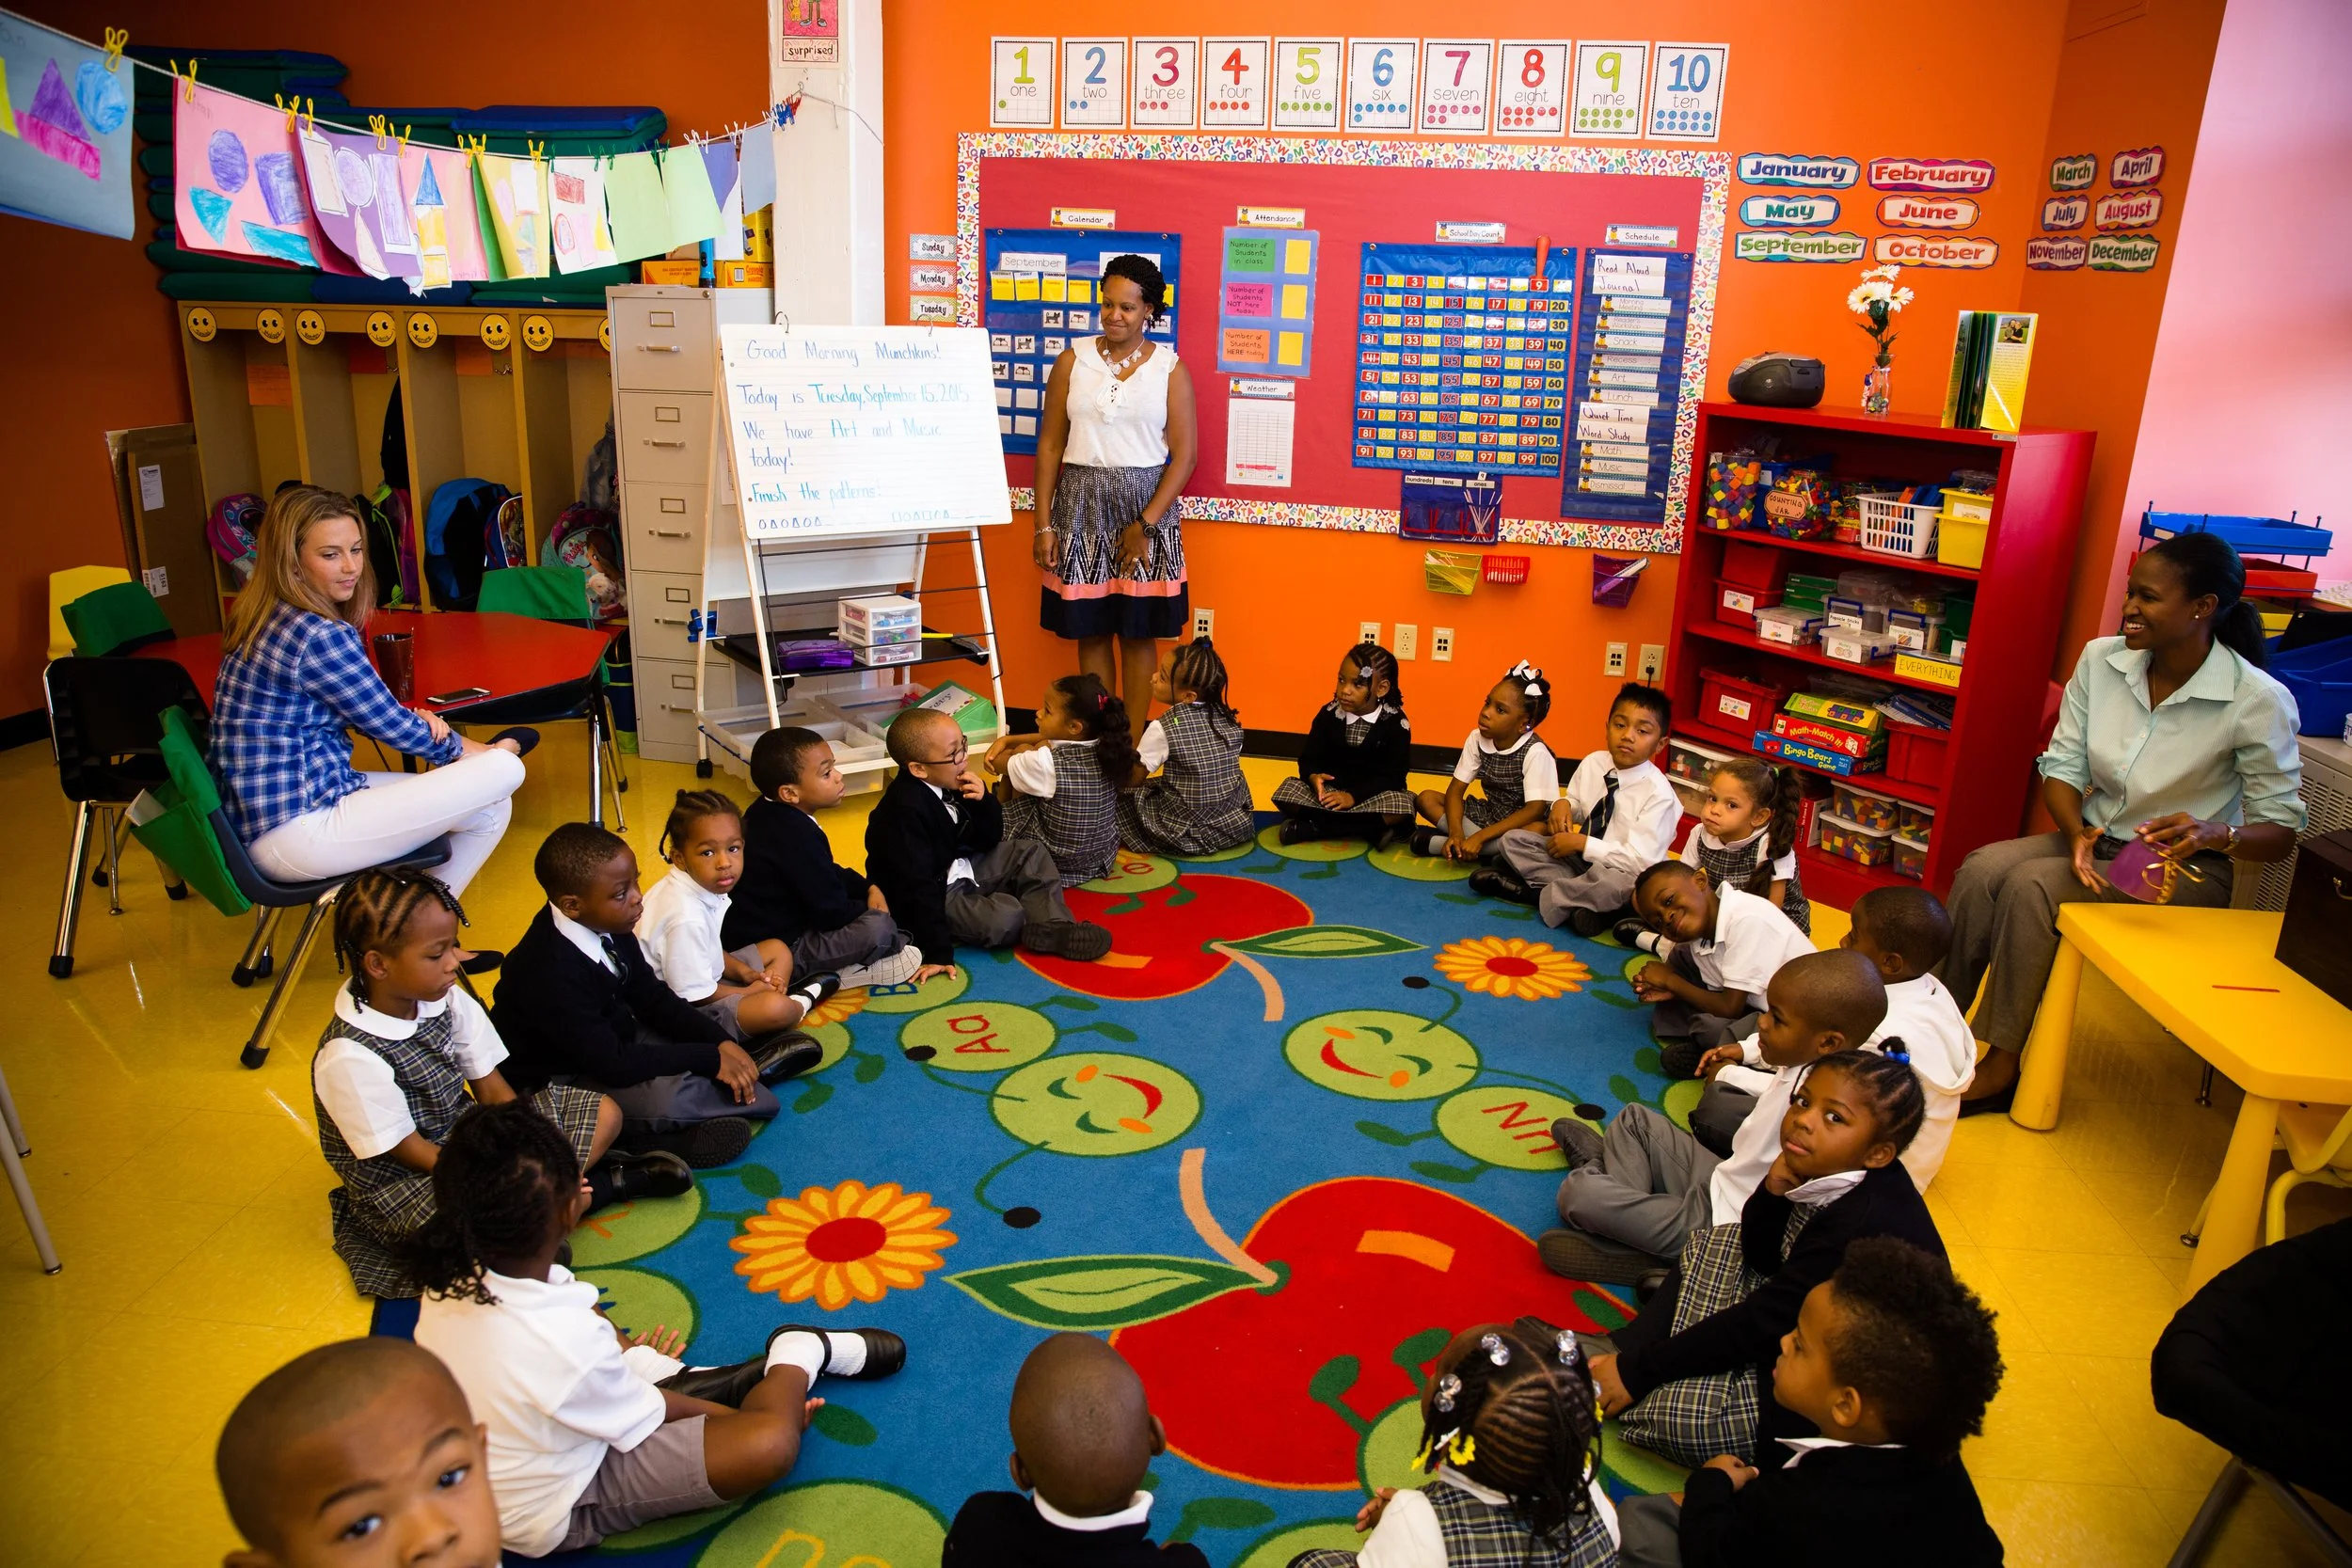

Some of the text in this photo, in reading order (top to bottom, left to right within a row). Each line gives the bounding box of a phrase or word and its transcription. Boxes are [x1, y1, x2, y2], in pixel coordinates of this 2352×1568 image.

[788, 44, 833, 58] surprised
[1014, 46, 1035, 84] 1
[1086, 47, 1106, 84] 2
[1152, 46, 1179, 86] 3
[1222, 48, 1249, 85] 4
[1296, 47, 1321, 85] 5
[1373, 49, 1393, 87] 6
[1445, 51, 1470, 87] 7
[1521, 49, 1546, 87] 8
[1596, 53, 1621, 93] 9
[1667, 55, 1710, 93] 10
[1010, 86, 1036, 97] one
[1082, 86, 1106, 98] two
[1145, 86, 1185, 99] three
[1220, 85, 1252, 99] four
[1295, 85, 1321, 99] five
[1373, 87, 1391, 100] six
[1433, 89, 1478, 101] seven
[1515, 89, 1549, 104] eight
[1593, 92, 1625, 105] nine
[1673, 95, 1699, 108] ten
[1751, 161, 1847, 182] January
[1875, 166, 1987, 185] February
[2057, 166, 2090, 182] March
[2122, 159, 2153, 177] April
[1765, 203, 1815, 220] May
[1899, 203, 1958, 219] June
[2053, 206, 2077, 224] July
[2105, 201, 2153, 220] August
[1069, 215, 1104, 224] Calendar
[1626, 232, 1659, 241] Schedule
[922, 243, 945, 254] Sunday
[1740, 238, 1862, 258] September
[1889, 242, 1986, 260] October
[2029, 245, 2084, 261] November
[2092, 243, 2155, 261] December
[1005, 256, 1061, 269] September
[1598, 259, 1649, 275] Read Aloud
[920, 274, 945, 285] Monday
[1535, 281, 1542, 290] 9
[1599, 276, 1640, 292] Journal
[1370, 296, 1377, 305] 11
[920, 304, 946, 316] Tuesday
[1231, 341, 1262, 349] Students
[1529, 340, 1541, 348] 39
[1613, 337, 1637, 345] Snack
[747, 340, 941, 367] Good Morning Munchkins!
[1607, 355, 1637, 363] Recess
[1612, 373, 1626, 382] Art
[736, 384, 778, 410] Today
[792, 392, 804, 404] is
[864, 384, 916, 410] September
[939, 384, 970, 403] 2015
[1608, 393, 1632, 402] Lunch
[1583, 407, 1633, 421] Quiet Time
[743, 421, 765, 440] We
[785, 421, 813, 440] have
[831, 419, 857, 437] Art
[872, 423, 892, 437] and
[1545, 418, 1558, 426] 80
[1580, 424, 1630, 442] Word Study
[1400, 450, 1412, 458] 93
[1541, 455, 1556, 464] 100
[1600, 446, 1621, 454] Math
[750, 448, 793, 474] today!
[1598, 463, 1622, 471] Music
[752, 483, 787, 503] Finish
[800, 482, 819, 500] the
[1590, 481, 1625, 489] Dismissal
[1770, 495, 1803, 508] COUNTING
[1775, 506, 1788, 515] JAR
[1899, 659, 1956, 681] EVERYTHING
[1789, 726, 1835, 742] Math-Match
[1835, 737, 1844, 748] It!
[1784, 743, 1806, 757] Bingo
[1807, 749, 1833, 764] Bears
[1818, 762, 1836, 770] Game
[946, 1015, 1009, 1053] Aa
